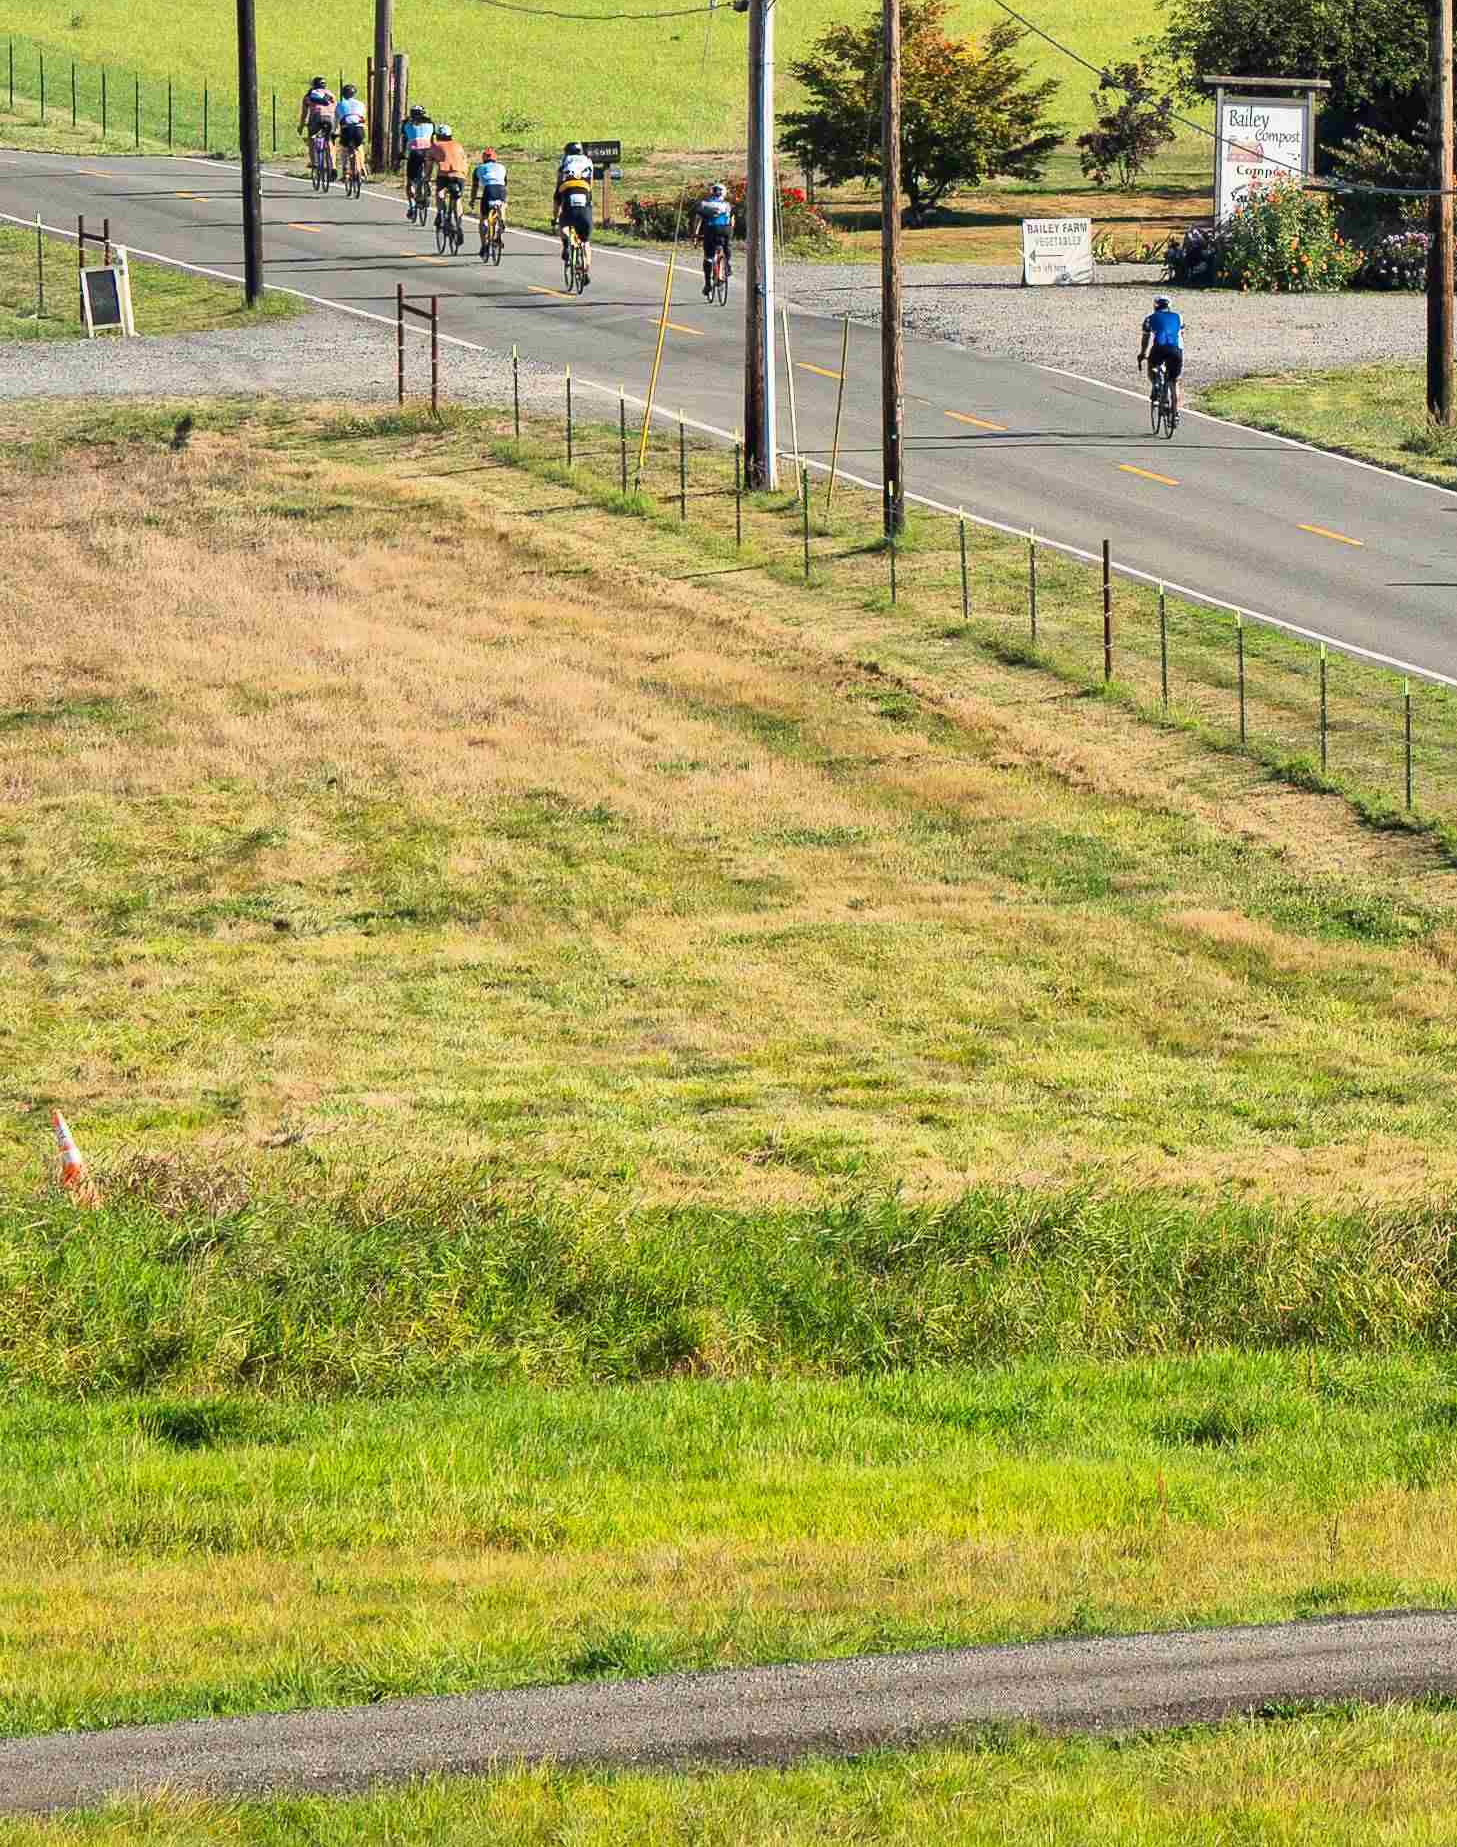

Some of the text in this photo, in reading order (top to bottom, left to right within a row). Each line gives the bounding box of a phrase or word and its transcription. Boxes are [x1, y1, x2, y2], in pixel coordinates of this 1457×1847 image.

[1229, 106, 1270, 130] Bailey
[1255, 129, 1301, 148] Compost
[1026, 222, 1087, 234] BAILEY FARM
